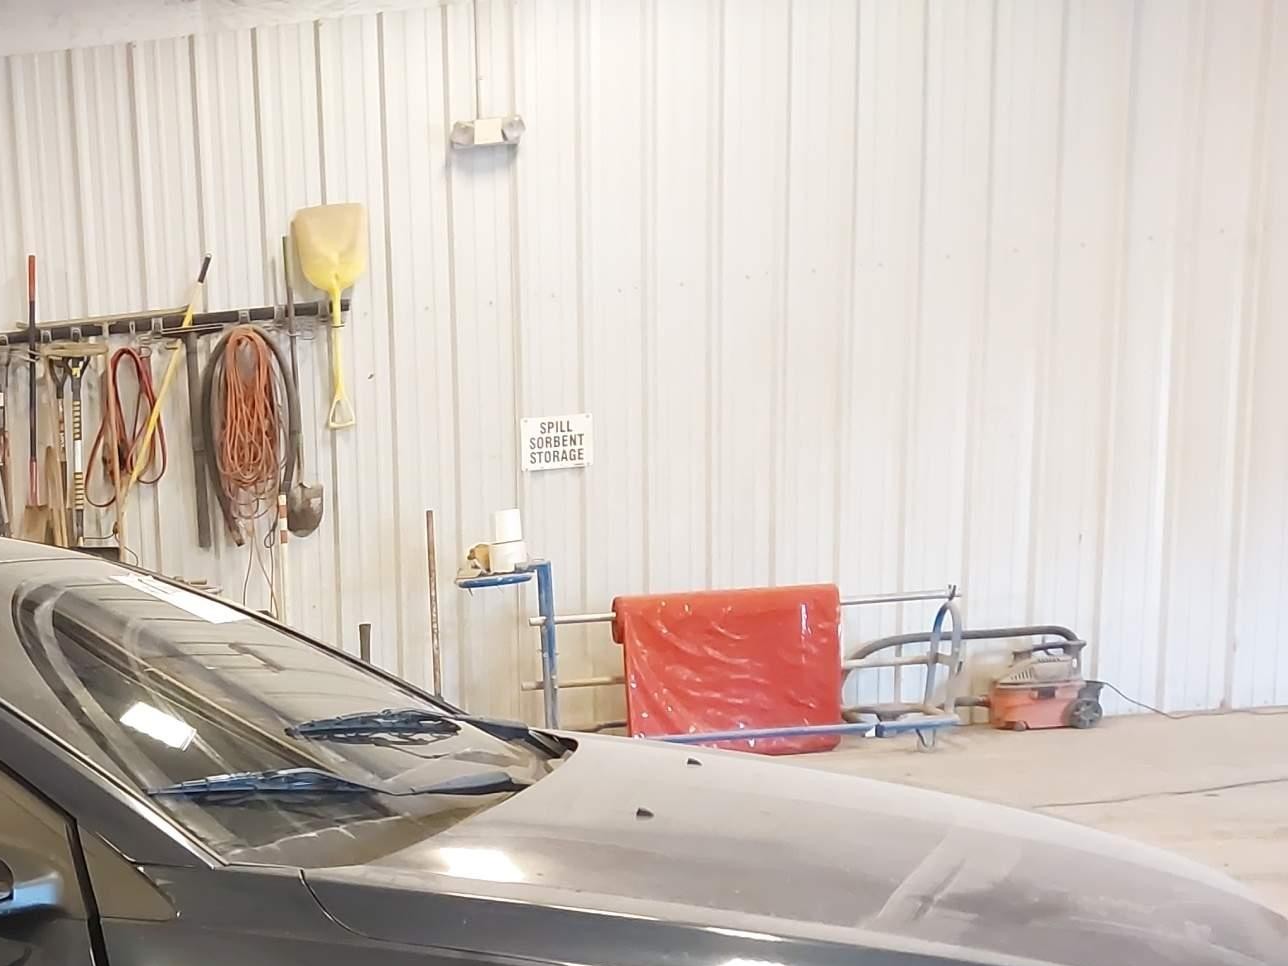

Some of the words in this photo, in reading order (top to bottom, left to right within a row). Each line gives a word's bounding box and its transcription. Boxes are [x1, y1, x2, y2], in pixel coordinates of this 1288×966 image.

[540, 420, 572, 434] SPILL
[529, 433, 584, 449] SORBENT
[529, 448, 584, 464] STORAGE
